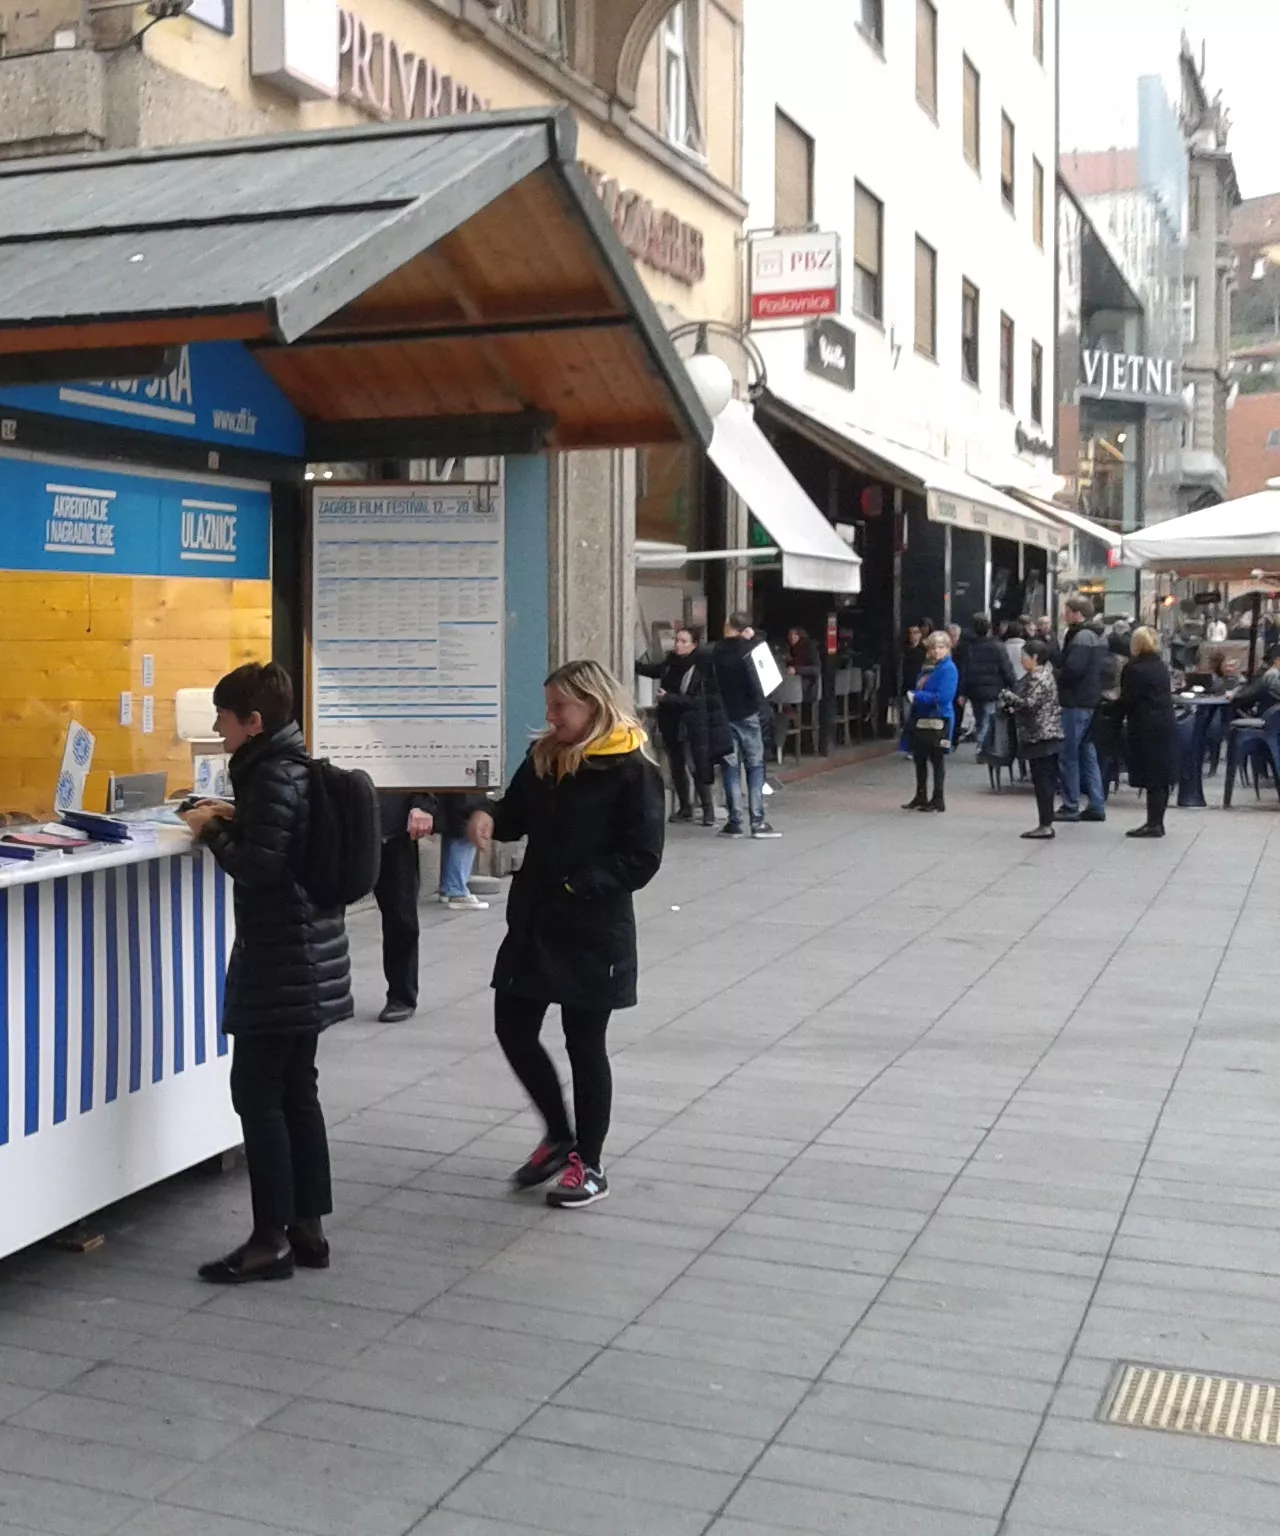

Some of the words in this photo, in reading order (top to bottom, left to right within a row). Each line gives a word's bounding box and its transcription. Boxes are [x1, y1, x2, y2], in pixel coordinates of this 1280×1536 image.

[790, 249, 833, 273] PBZ
[758, 295, 831, 314] Poslovnica
[1082, 349, 1174, 399] VJETNI
[318, 500, 357, 515] ZAGREB
[359, 500, 384, 515] FILM
[386, 500, 429, 515] FESTIVAL
[181, 511, 237, 552] ULAZNICE
